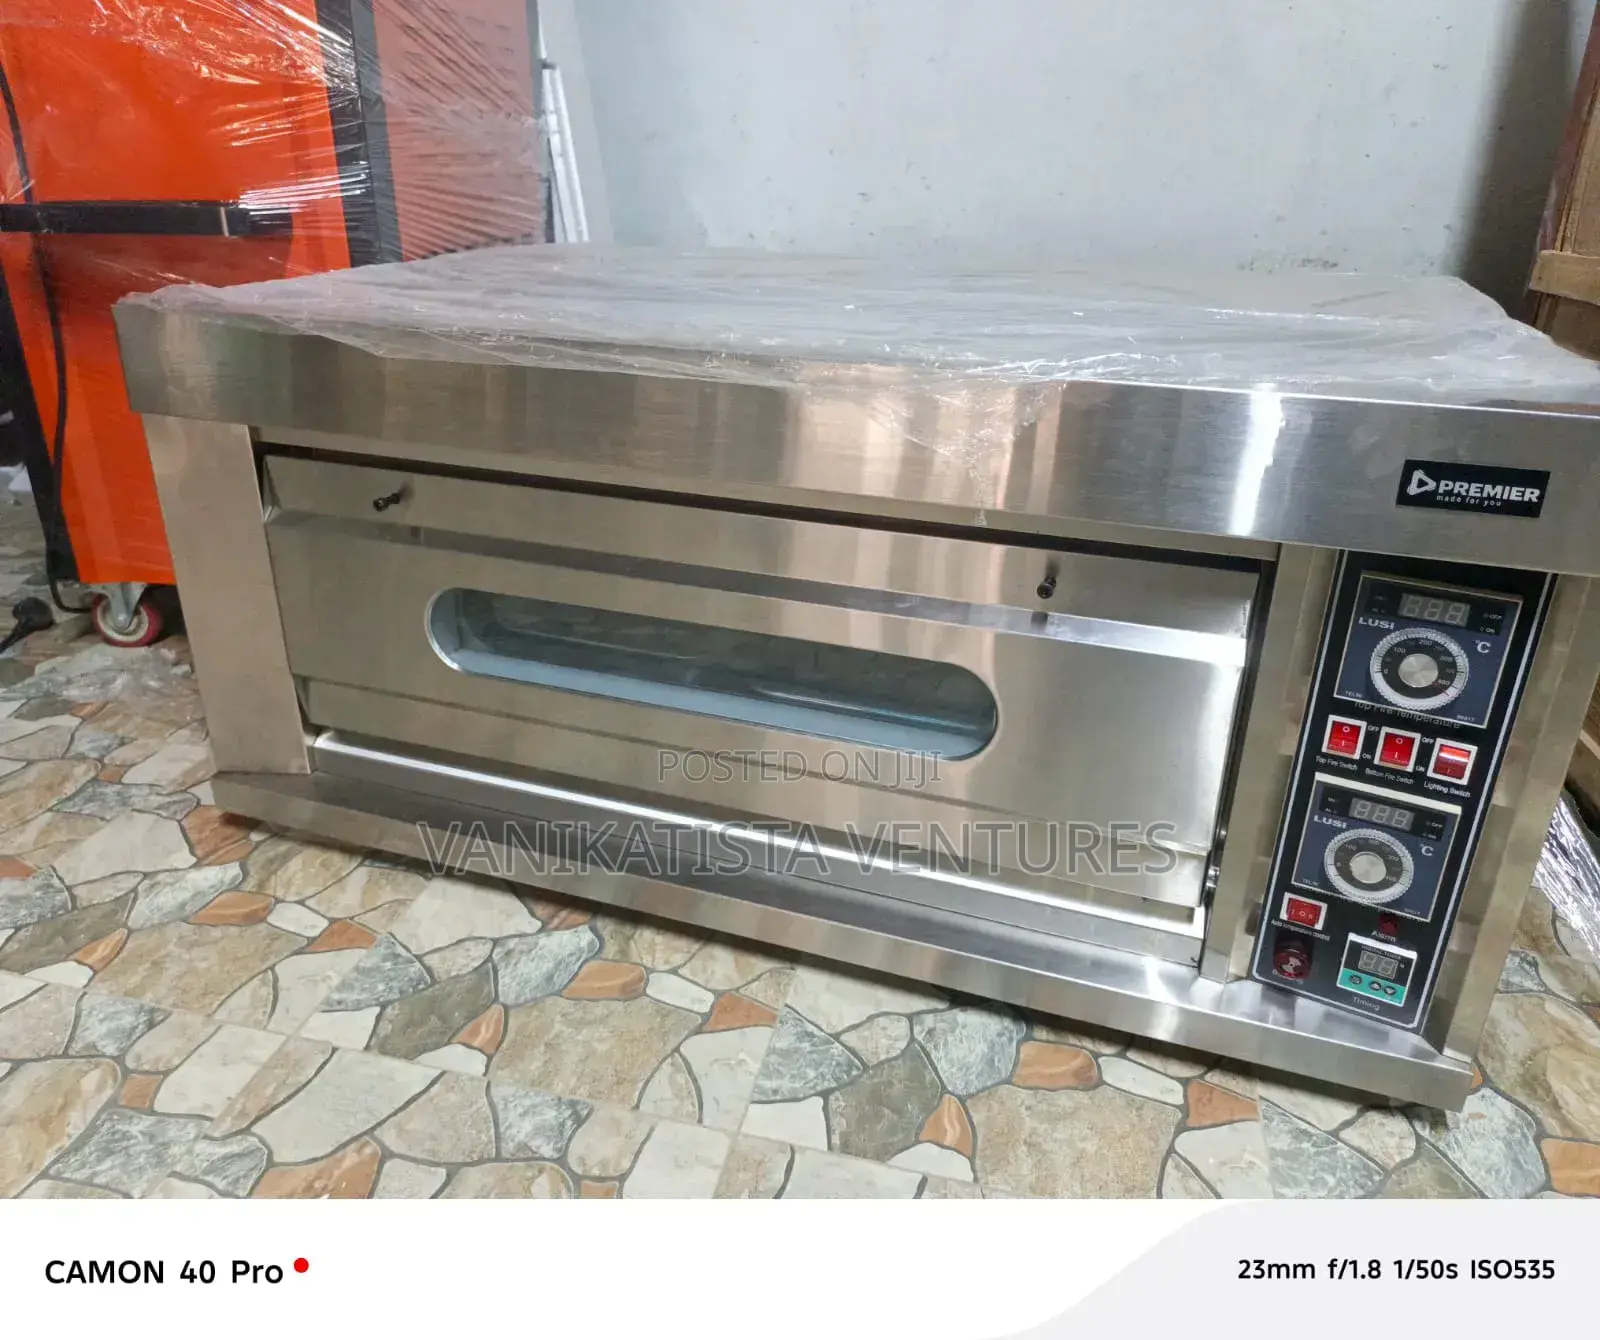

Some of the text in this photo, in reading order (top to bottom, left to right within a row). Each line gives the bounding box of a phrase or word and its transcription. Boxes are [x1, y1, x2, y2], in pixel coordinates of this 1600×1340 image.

[1438, 479, 1541, 503] PREMIER
[1436, 495, 1462, 503] made
[1465, 497, 1480, 505] for
[1358, 616, 1396, 630] LUSI
[1367, 724, 1380, 732] OFF
[1421, 737, 1434, 745] OFF
[1315, 755, 1358, 771] Top Fire Switch
[1396, 776, 1414, 785] Switch
[1423, 780, 1471, 799] Lighting Switch
[1313, 814, 1347, 829] LUSI
[1352, 996, 1381, 1012] Timing
